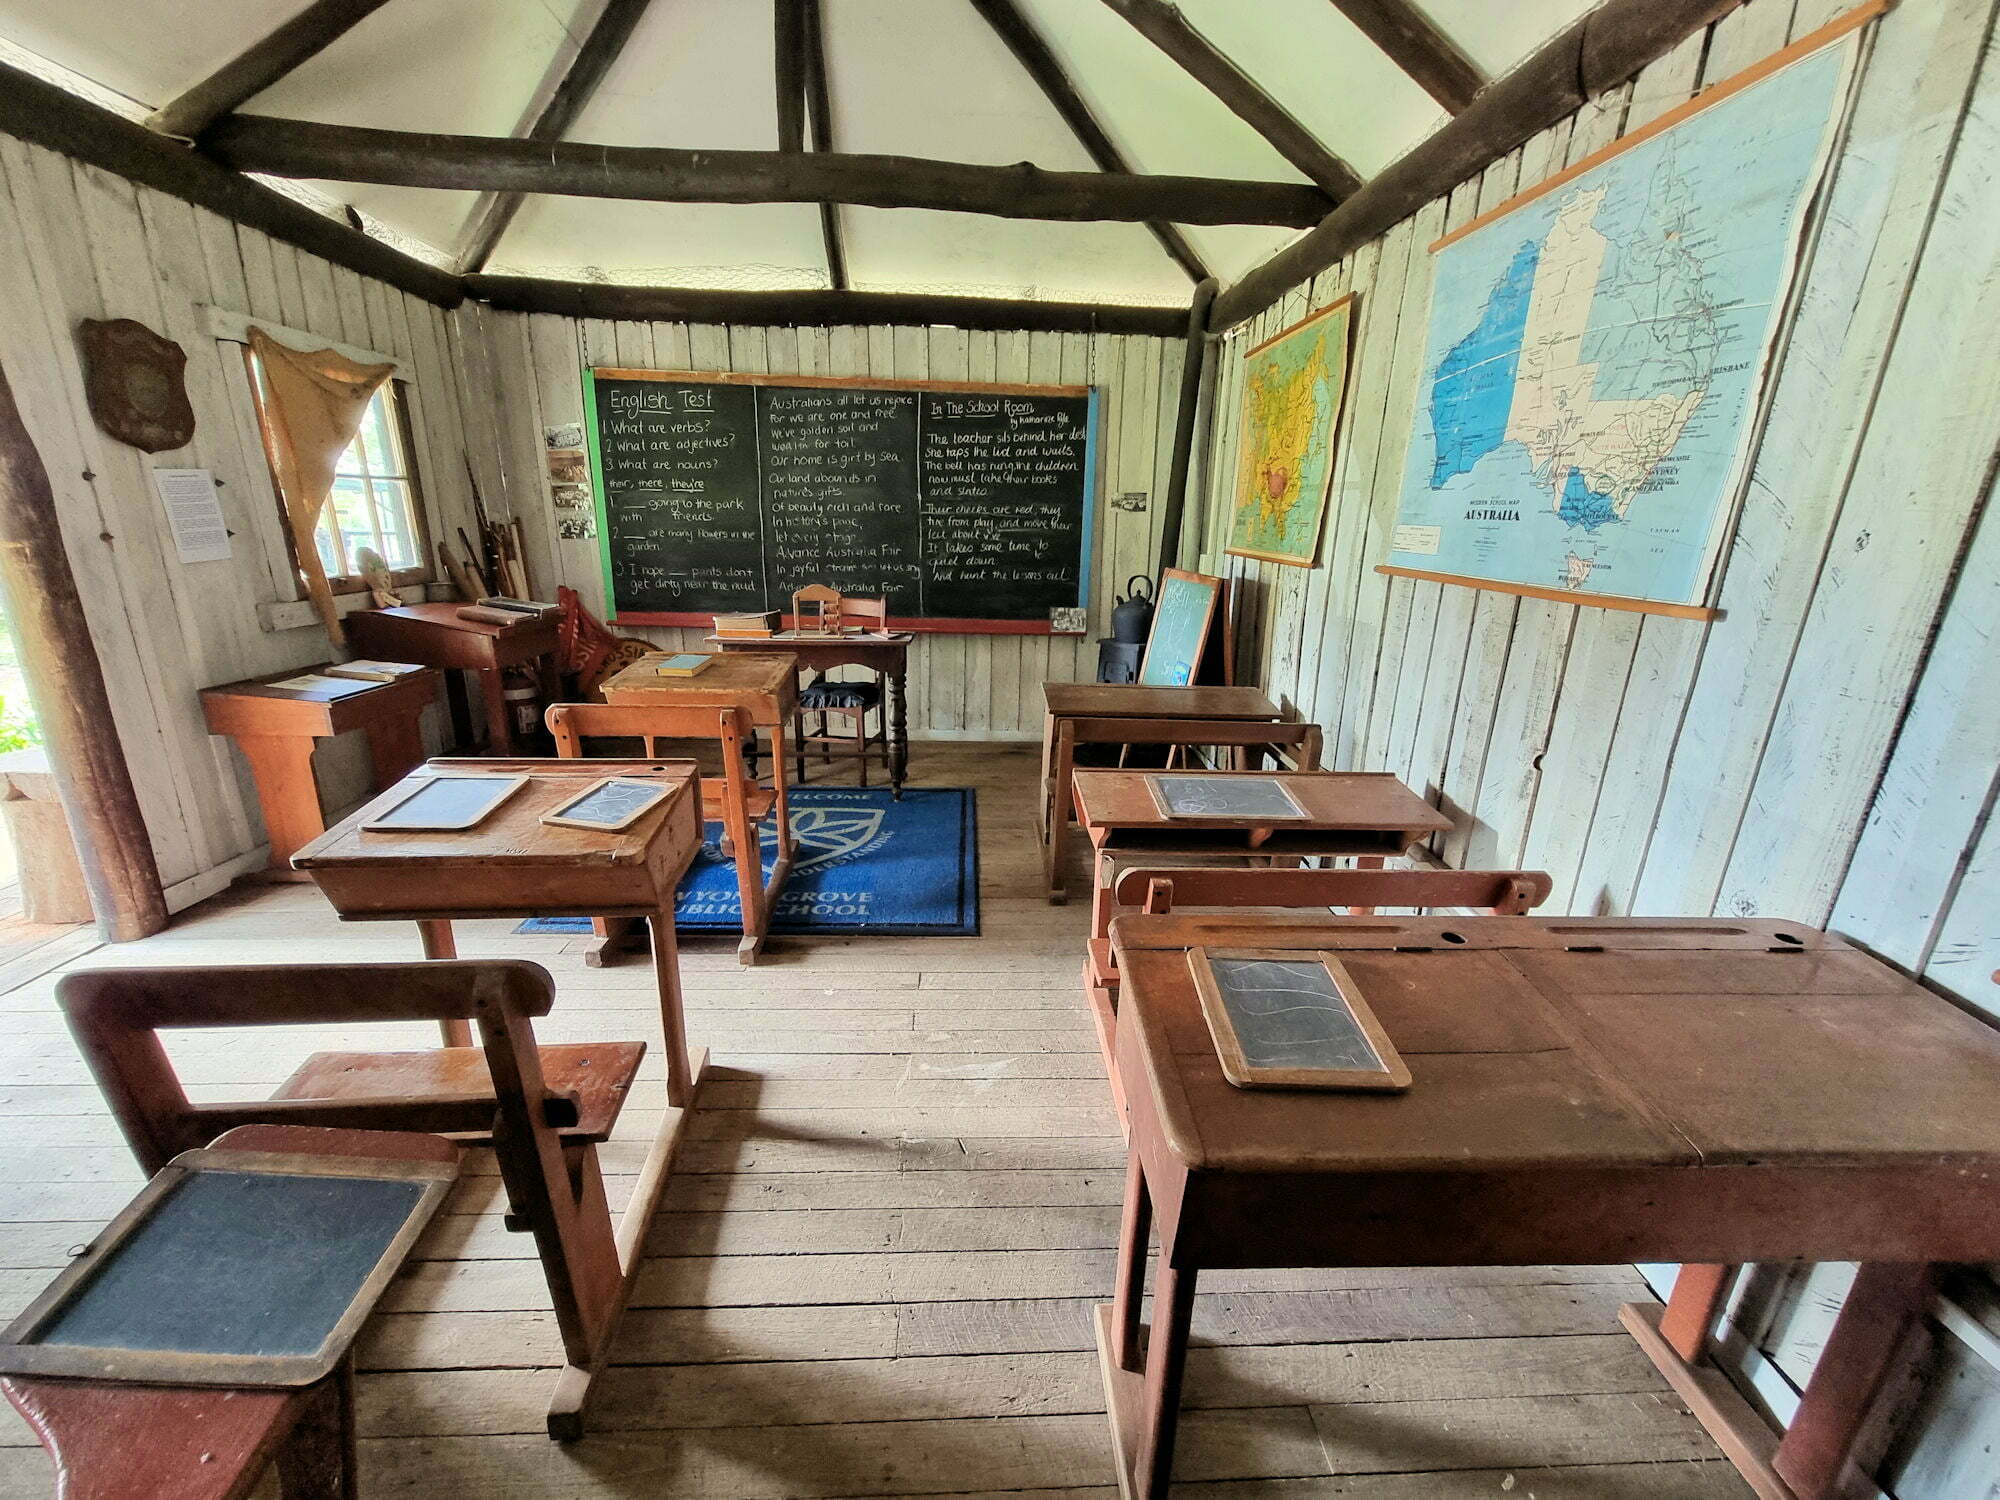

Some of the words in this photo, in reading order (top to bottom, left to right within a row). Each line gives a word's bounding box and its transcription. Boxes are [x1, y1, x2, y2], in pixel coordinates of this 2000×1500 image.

[611, 389, 674, 419] English
[678, 389, 712, 407] Test
[769, 396, 833, 410] Australians
[837, 395, 848, 405] all
[853, 394, 867, 405] let
[869, 397, 881, 405] us
[930, 402, 943, 415] In
[945, 401, 964, 415] The
[965, 399, 1000, 414] School
[1004, 399, 1035, 417] Room
[789, 413, 804, 423] we
[807, 412, 825, 422] are
[829, 411, 848, 420] one
[851, 410, 871, 420] and
[874, 408, 897, 419] free
[610, 419, 643, 434] What
[648, 423, 667, 433] are
[671, 420, 712, 433] verbs?
[837, 422, 854, 433] soil
[858, 421, 879, 432] and
[651, 441, 671, 450] are
[676, 433, 735, 454] adjectives?
[815, 438, 830, 449] for
[926, 433, 949, 445] The
[953, 432, 993, 445] teacher
[1049, 430, 1065, 441] her
[770, 455, 789, 467] Our
[793, 455, 823, 466] home
[826, 455, 838, 465] is
[840, 451, 861, 469] girt
[864, 450, 876, 467] by
[924, 446, 945, 459] She
[946, 447, 970, 461] taps
[973, 445, 989, 458] the
[1015, 445, 1038, 458] and
[652, 461, 671, 469] are
[677, 459, 718, 469] nouns?
[924, 460, 943, 471] The
[944, 460, 963, 471] bell
[967, 460, 987, 471] has
[1035, 459, 1080, 472] children
[672, 478, 704, 491] they're
[768, 472, 786, 484] Our
[787, 473, 811, 484] land
[864, 474, 877, 483] in
[928, 474, 949, 485] now
[950, 471, 977, 484] must
[1031, 474, 1059, 485] books
[929, 485, 952, 497] and
[648, 499, 679, 513] going
[696, 499, 712, 509] the
[716, 498, 744, 512] park
[787, 501, 824, 518] beauty
[826, 502, 851, 512] rich
[853, 501, 876, 513] and
[926, 502, 953, 514] Their
[992, 506, 1010, 515] are
[772, 514, 784, 528] In
[947, 515, 969, 527] from
[999, 518, 1020, 529] and
[1023, 519, 1049, 530] move
[1464, 509, 1521, 521] AUSTRALIA
[926, 541, 938, 554] It
[945, 541, 975, 555] takes
[980, 542, 1004, 554] some
[1008, 540, 1031, 553] time
[1038, 538, 1050, 552] to
[776, 563, 787, 574] In
[789, 561, 820, 578] joyful
[932, 570, 953, 582] And
[630, 579, 650, 595] get
[655, 578, 681, 597] dirty
[881, 581, 905, 593] Fair
[789, 831, 896, 878] NDERSTANDING
[781, 891, 872, 902] GROVE
[775, 904, 870, 915] CHOOL
